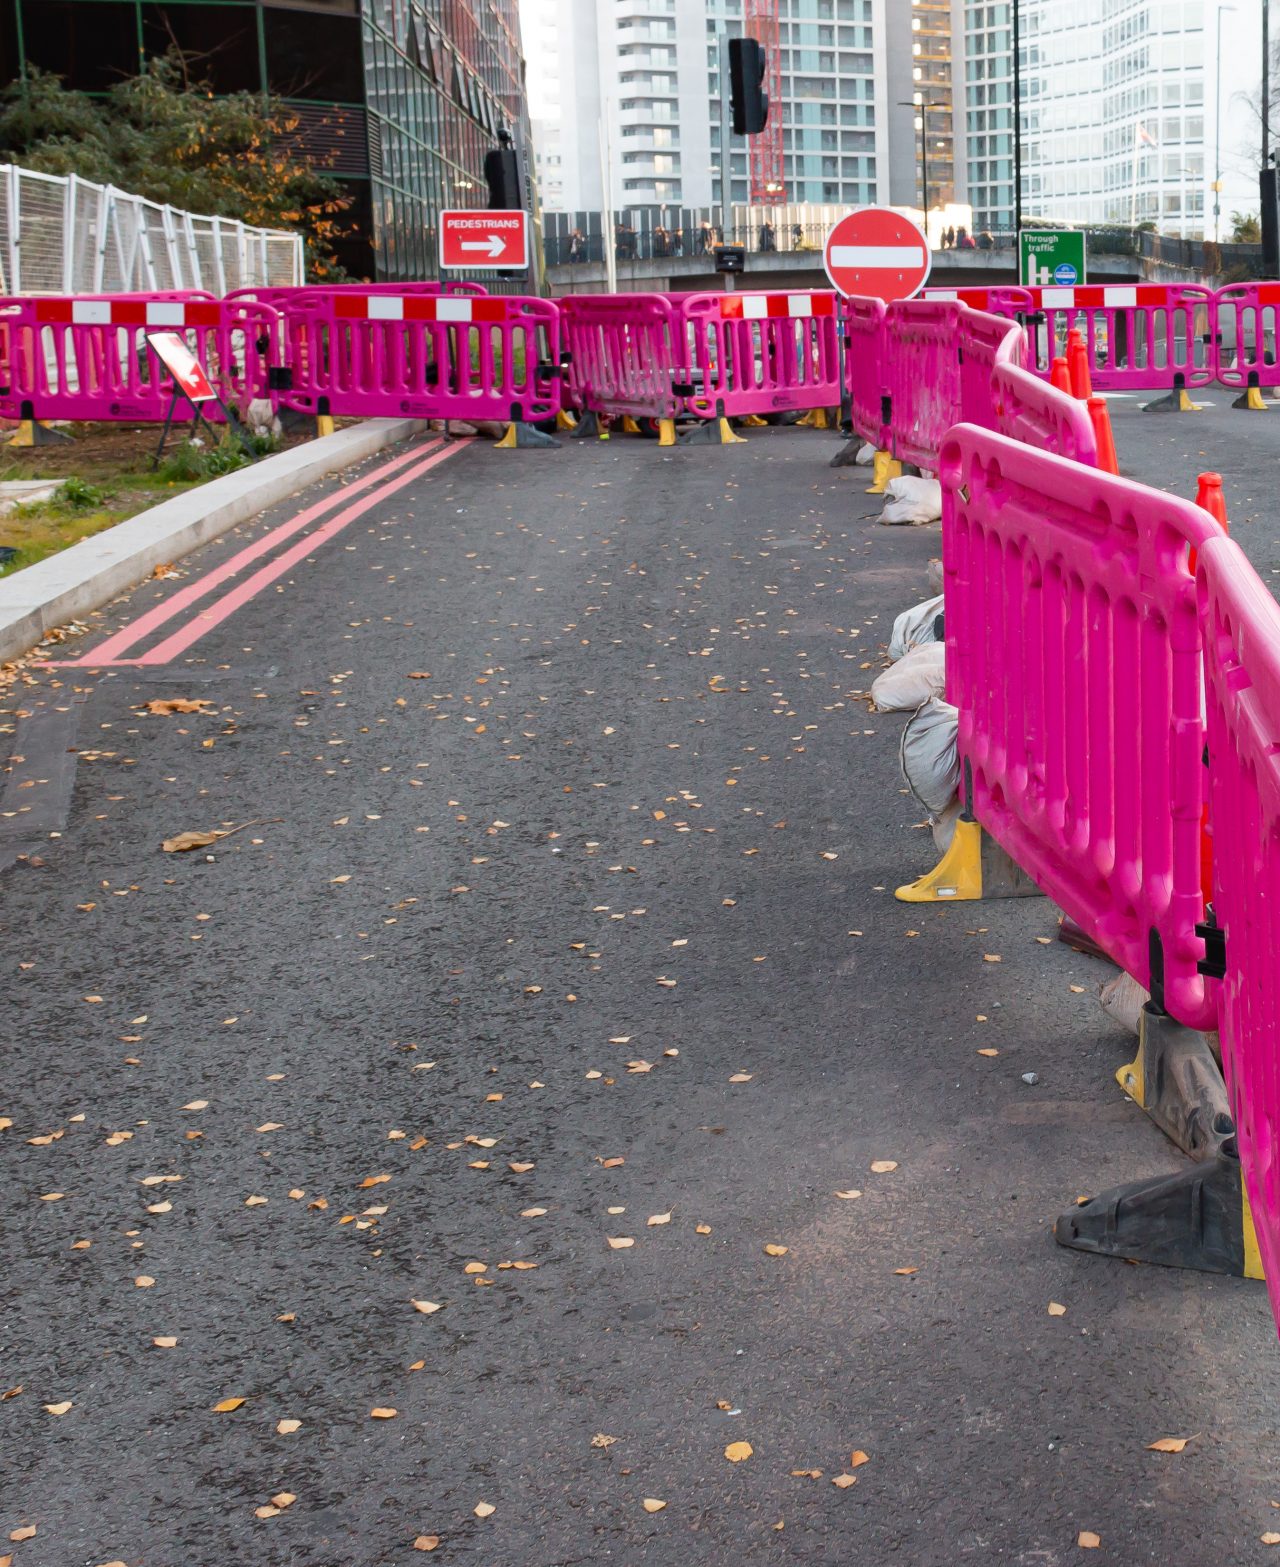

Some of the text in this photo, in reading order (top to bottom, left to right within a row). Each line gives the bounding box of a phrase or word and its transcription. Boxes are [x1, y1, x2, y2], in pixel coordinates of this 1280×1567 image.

[447, 219, 520, 229] PEDESTRIANS
[1023, 234, 1059, 244] Through
[1028, 243, 1055, 252] traffic
